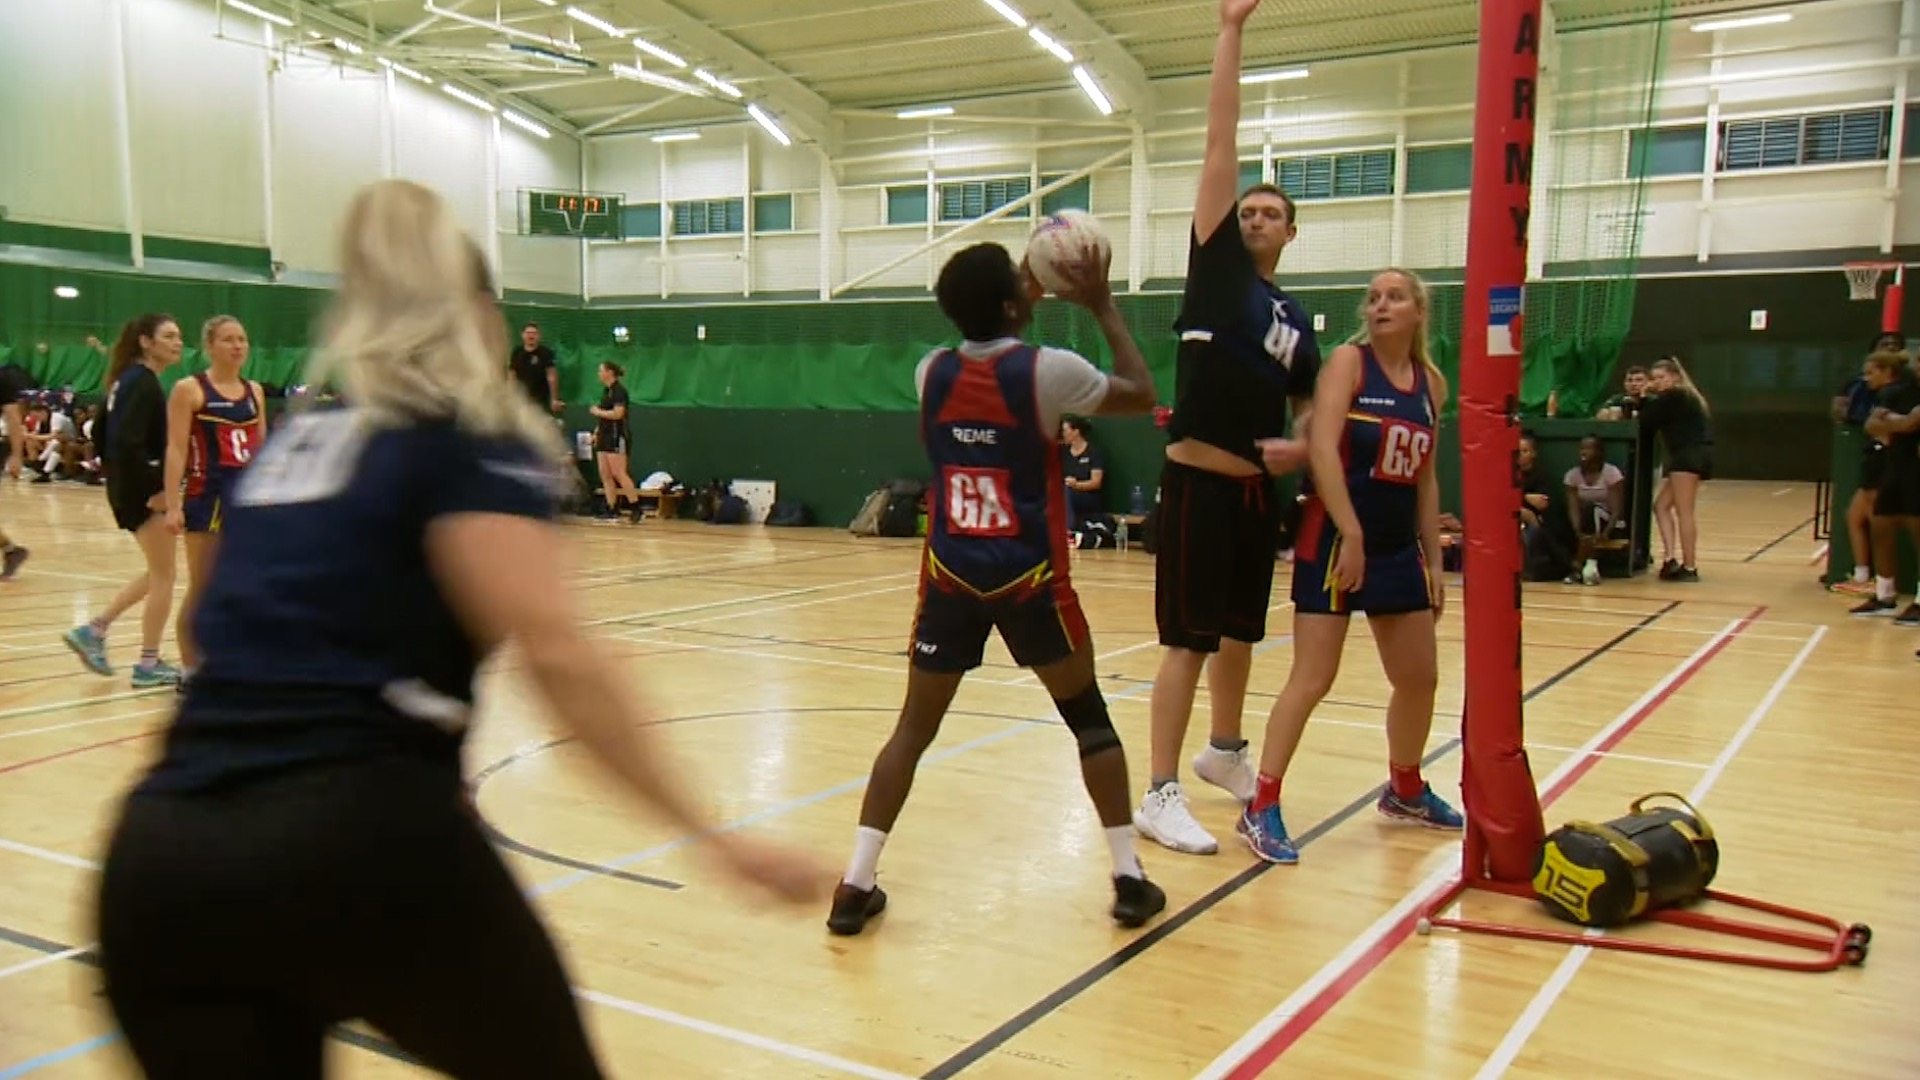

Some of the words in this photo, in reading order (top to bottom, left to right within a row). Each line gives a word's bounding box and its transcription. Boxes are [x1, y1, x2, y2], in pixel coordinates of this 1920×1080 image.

[1504, 12, 1538, 248] ARMY
[231, 428, 250, 462] C
[952, 426, 998, 444] REME
[1382, 424, 1430, 478] GS
[951, 472, 1011, 528] GA
[1545, 864, 1588, 909] 15
